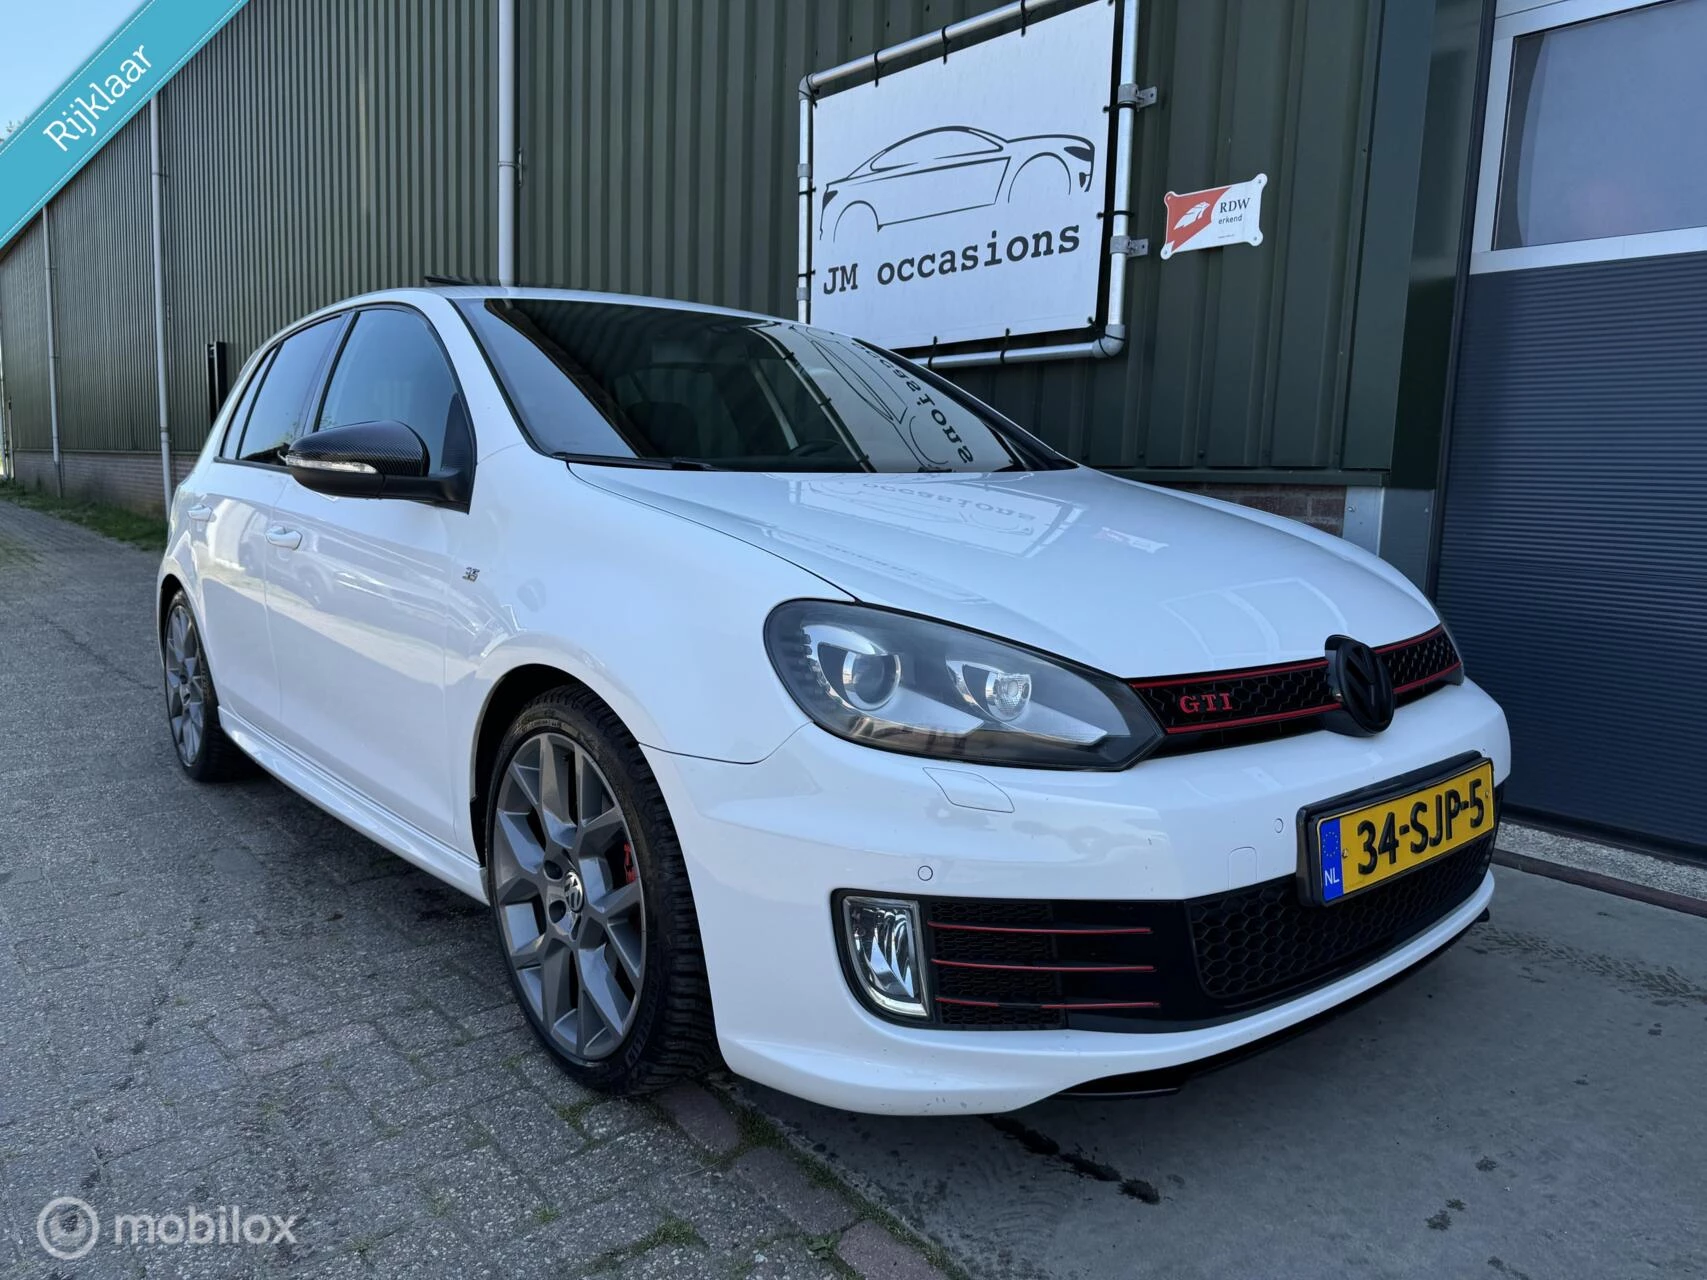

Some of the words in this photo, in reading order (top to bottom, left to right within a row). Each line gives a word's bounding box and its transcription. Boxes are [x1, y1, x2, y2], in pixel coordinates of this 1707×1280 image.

[1219, 197, 1251, 213] RDW
[1218, 214, 1243, 225] erkend
[822, 263, 858, 295] JM
[877, 224, 1081, 285] occasions
[1180, 692, 1233, 714] GTI
[1358, 778, 1484, 875] 34-SJP-5
[1324, 868, 1340, 886] NL
